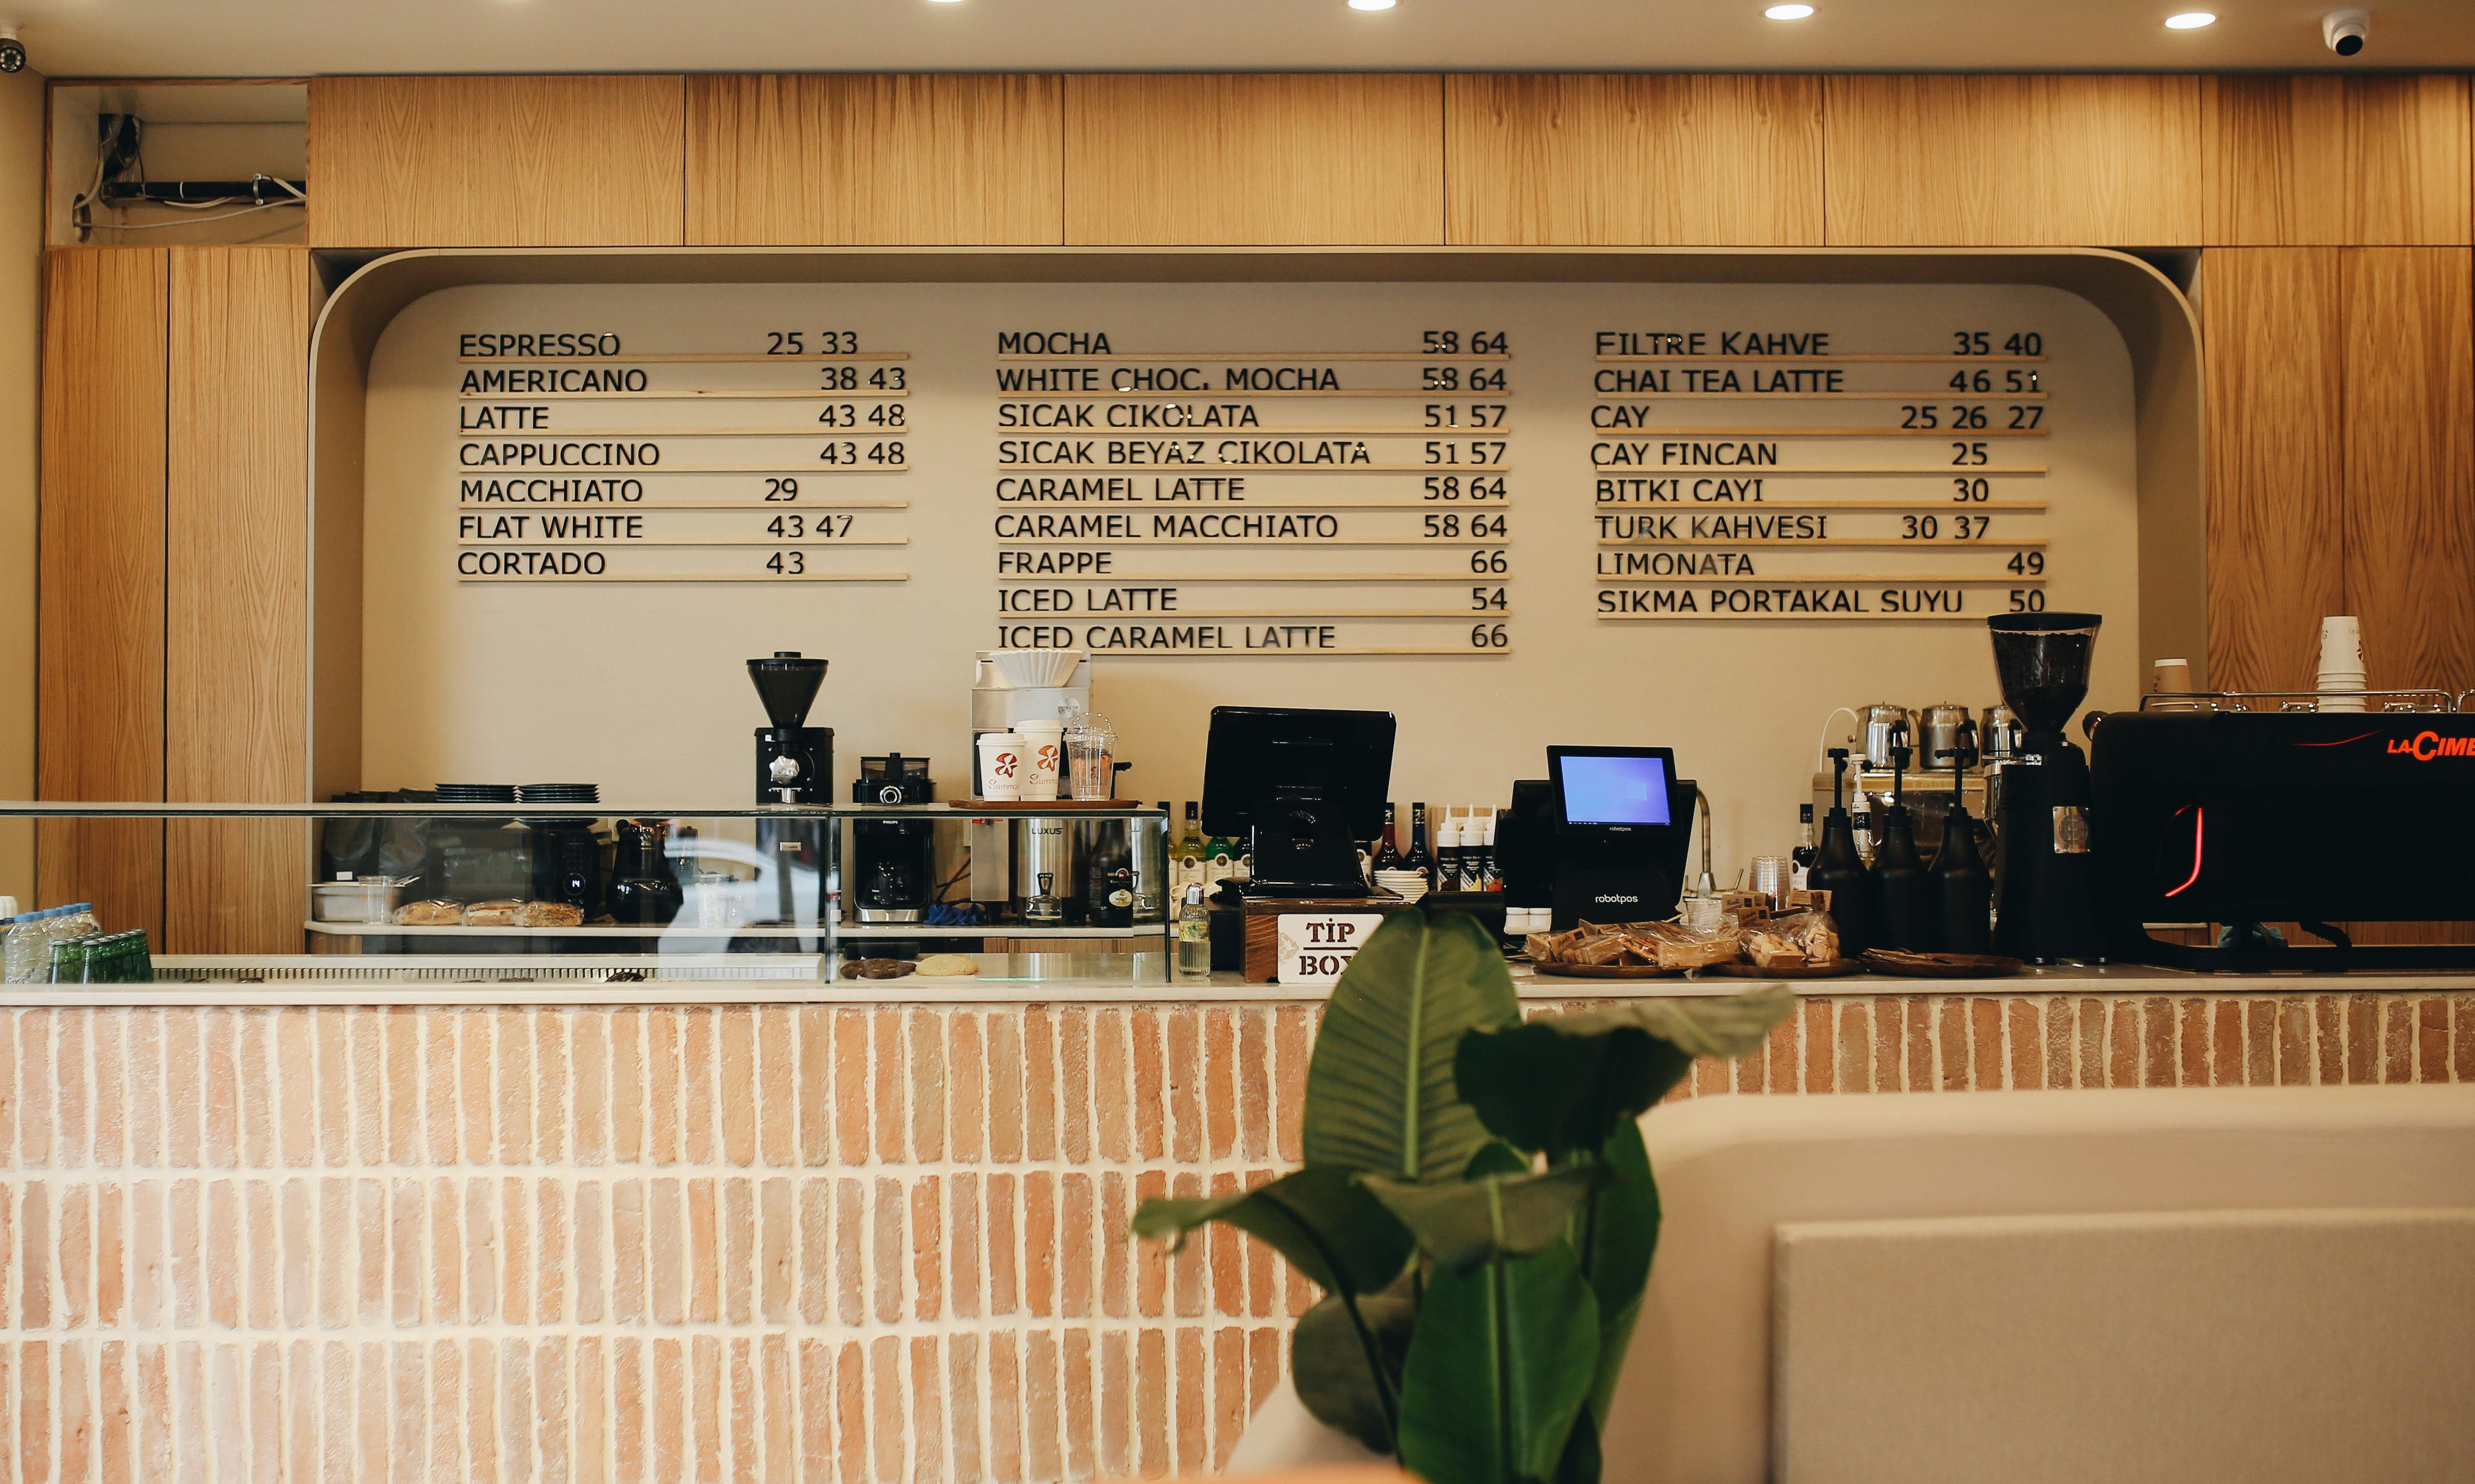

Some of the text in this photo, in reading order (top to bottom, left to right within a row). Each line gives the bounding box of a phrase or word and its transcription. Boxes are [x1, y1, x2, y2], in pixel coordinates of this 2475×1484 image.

[460, 331, 858, 357] ESPRESSO 25 33
[998, 330, 1508, 355] MOCHA 58 64
[1595, 331, 2042, 356] FILTRE KAHVE 35 40
[460, 367, 906, 393] AMERICANO 38 43
[996, 367, 1507, 392] WHITE CHOC. MOCHA 58 64
[1594, 368, 2043, 394] CHAI TEA LATTE 46 51
[460, 404, 905, 429] LATTE 43 48
[999, 404, 1506, 428] SICAK CIKOLATA 51 57
[1591, 405, 2045, 430] CAY 25 26 27
[460, 442, 905, 466] CAPPUCCINO 43 48
[999, 441, 1506, 464] SICAK BEYAZ CIKOLATA 51 57
[1590, 442, 1988, 466] CAY FINCAN 25
[461, 478, 797, 502] MACCHIATO 29
[997, 476, 1506, 501] CARAMEL LATTE 58 64
[1597, 478, 1989, 502] BITKI CAYI 30
[460, 515, 853, 538] FLAT WHITE 43 47
[995, 514, 1507, 538] CARAMEL MACCHIATO 58 64
[1594, 515, 1990, 539] TURK KAHVESI 30 37
[458, 551, 804, 575] CORTADO 43
[999, 550, 1507, 574] FRAPPE 66
[1597, 551, 2044, 575] LIMONATA 49
[999, 587, 1507, 612] ICED LATTE 54
[1598, 589, 2045, 613] SIKMA PORTAKAL SUYU 50
[999, 624, 1507, 648] ICED CARAMEL LATTE 66
[1595, 894, 1638, 904] robotpos
